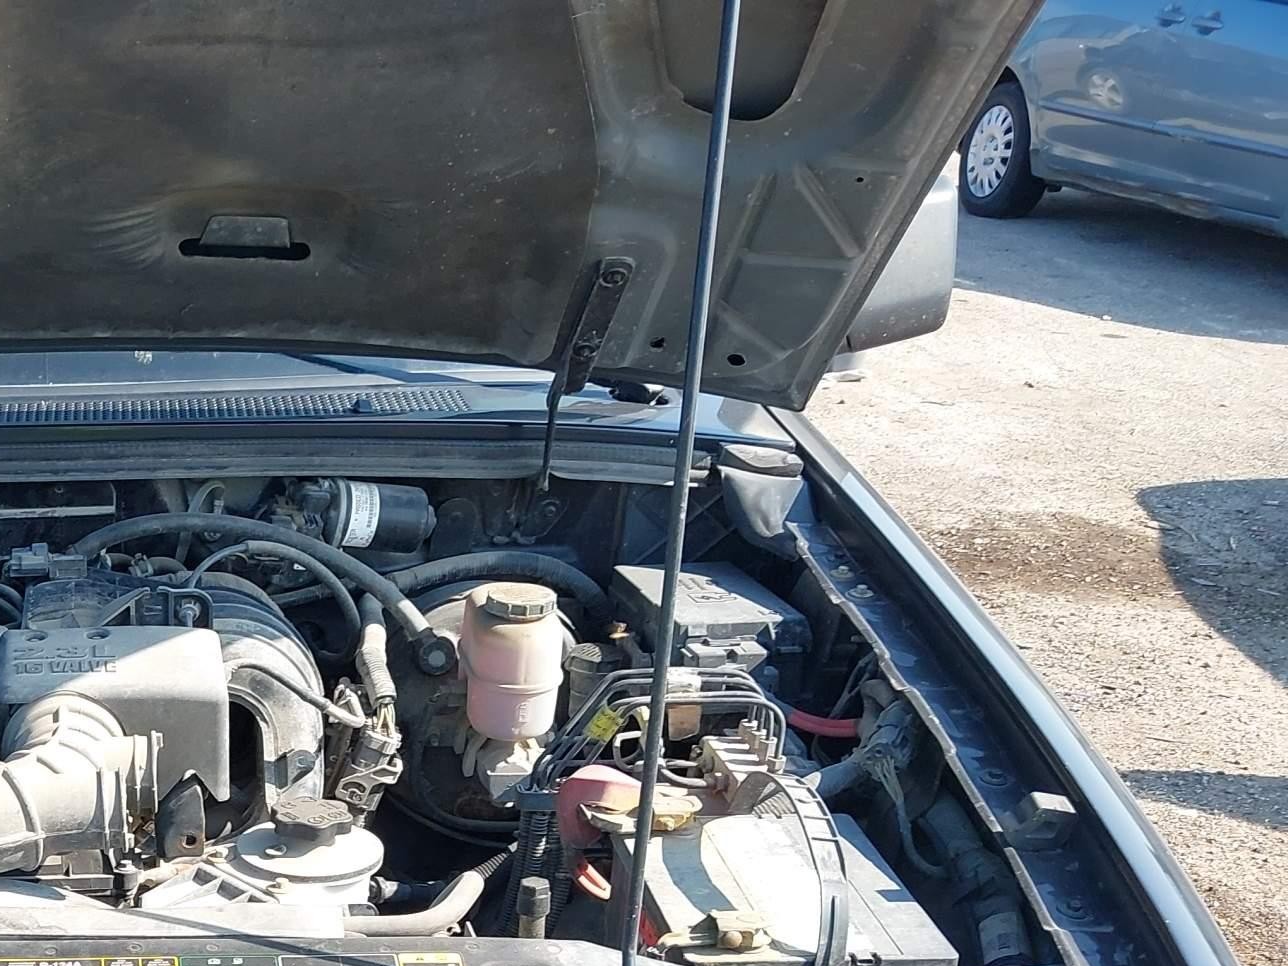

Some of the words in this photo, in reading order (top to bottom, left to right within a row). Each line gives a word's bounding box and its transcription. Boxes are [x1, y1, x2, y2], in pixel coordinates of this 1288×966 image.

[13, 644, 116, 660] 2.3L
[14, 661, 44, 675] 16
[50, 660, 118, 674] VALVE
